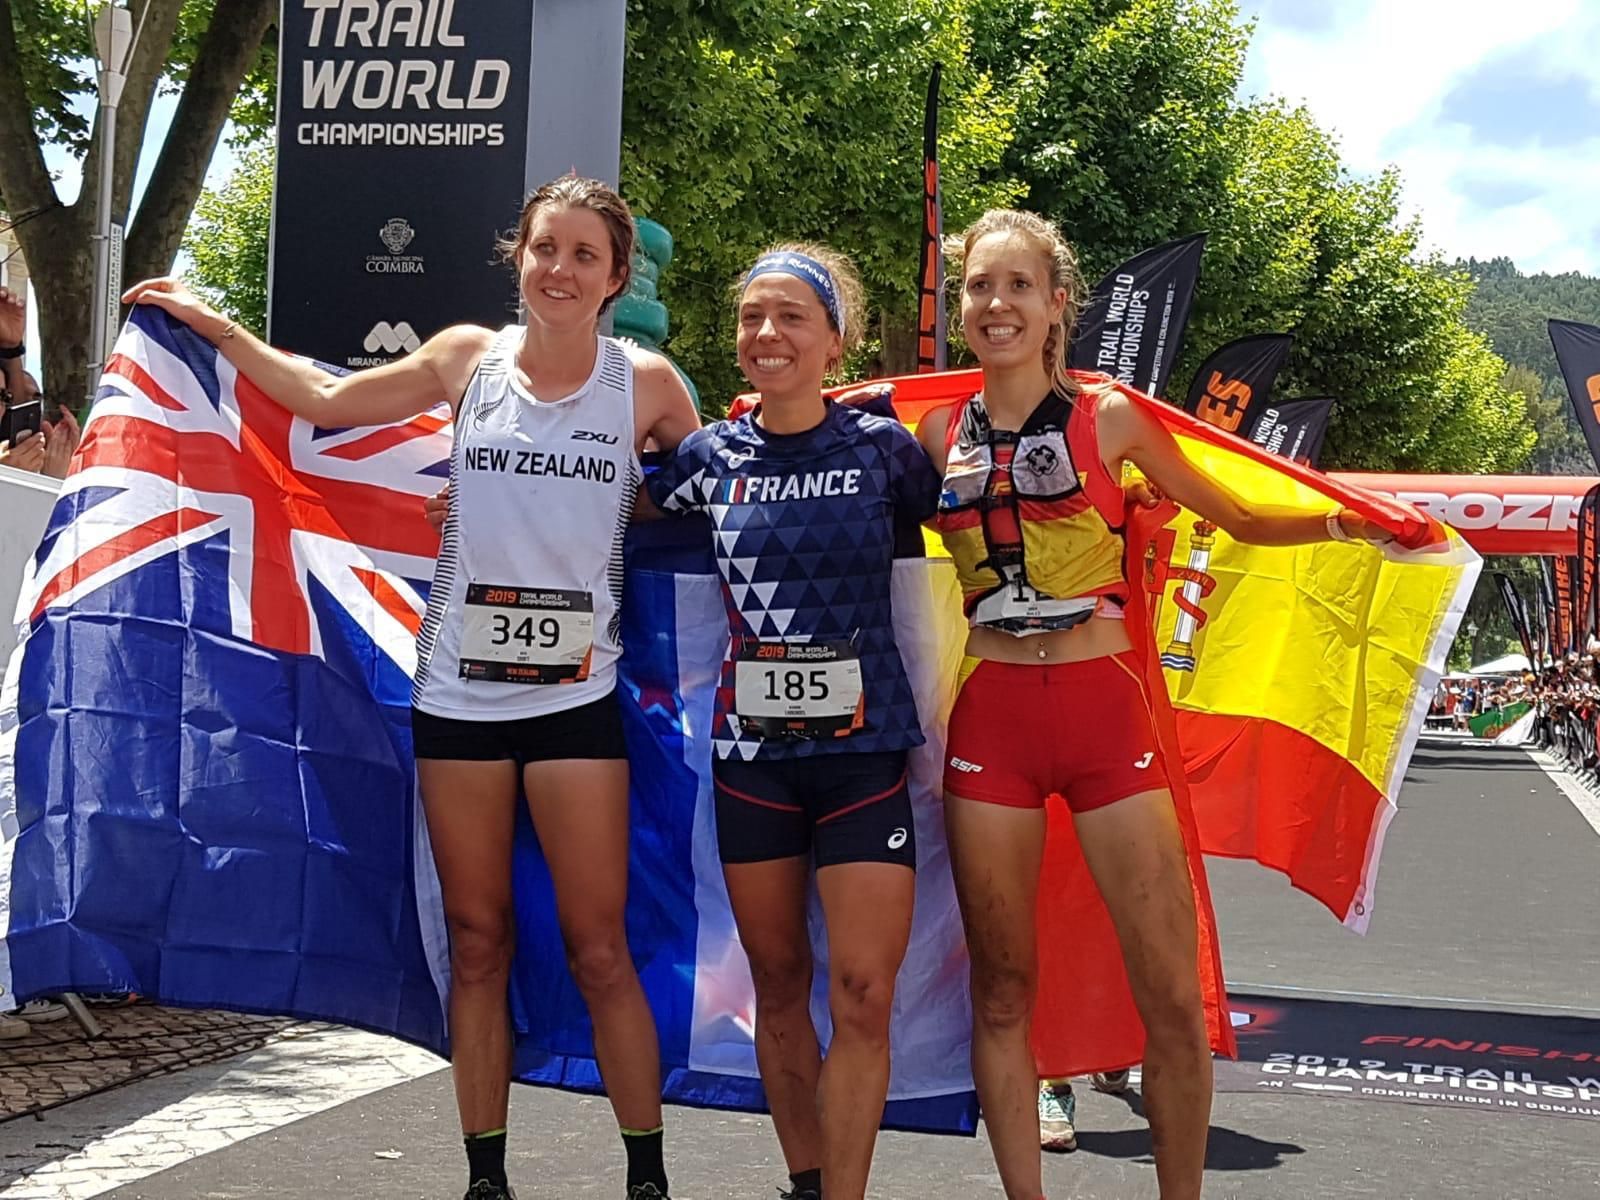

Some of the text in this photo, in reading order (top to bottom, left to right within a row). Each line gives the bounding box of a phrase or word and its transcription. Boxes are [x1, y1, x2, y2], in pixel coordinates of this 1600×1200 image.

[302, 0, 465, 47] TRAIL
[302, 60, 511, 109] WORLD
[297, 123, 505, 146] CHAMPIONSHIPS
[366, 261, 424, 273] COIMBRA
[1097, 273, 1134, 367] TRAIL WORLD
[1118, 290, 1150, 389] AMPIONSHIPS
[1253, 408, 1280, 444] WORLD
[465, 447, 616, 484] NEW ZEALAND
[744, 469, 861, 503] FRANCE
[485, 589, 517, 604] 2019
[540, 593, 562, 601] WORLD
[491, 614, 560, 648] 349
[757, 646, 785, 657] 2019
[764, 670, 829, 701] 185
[950, 756, 984, 773] ESP
[1360, 1035, 1600, 1062] FINISH
[1266, 1053, 1386, 1069] 2019
[1403, 1063, 1549, 1085] TRAIL
[1256, 1080, 1284, 1088] AN
[1361, 1087, 1492, 1105] COMPETITION
[1499, 1099, 1519, 1108] IN
